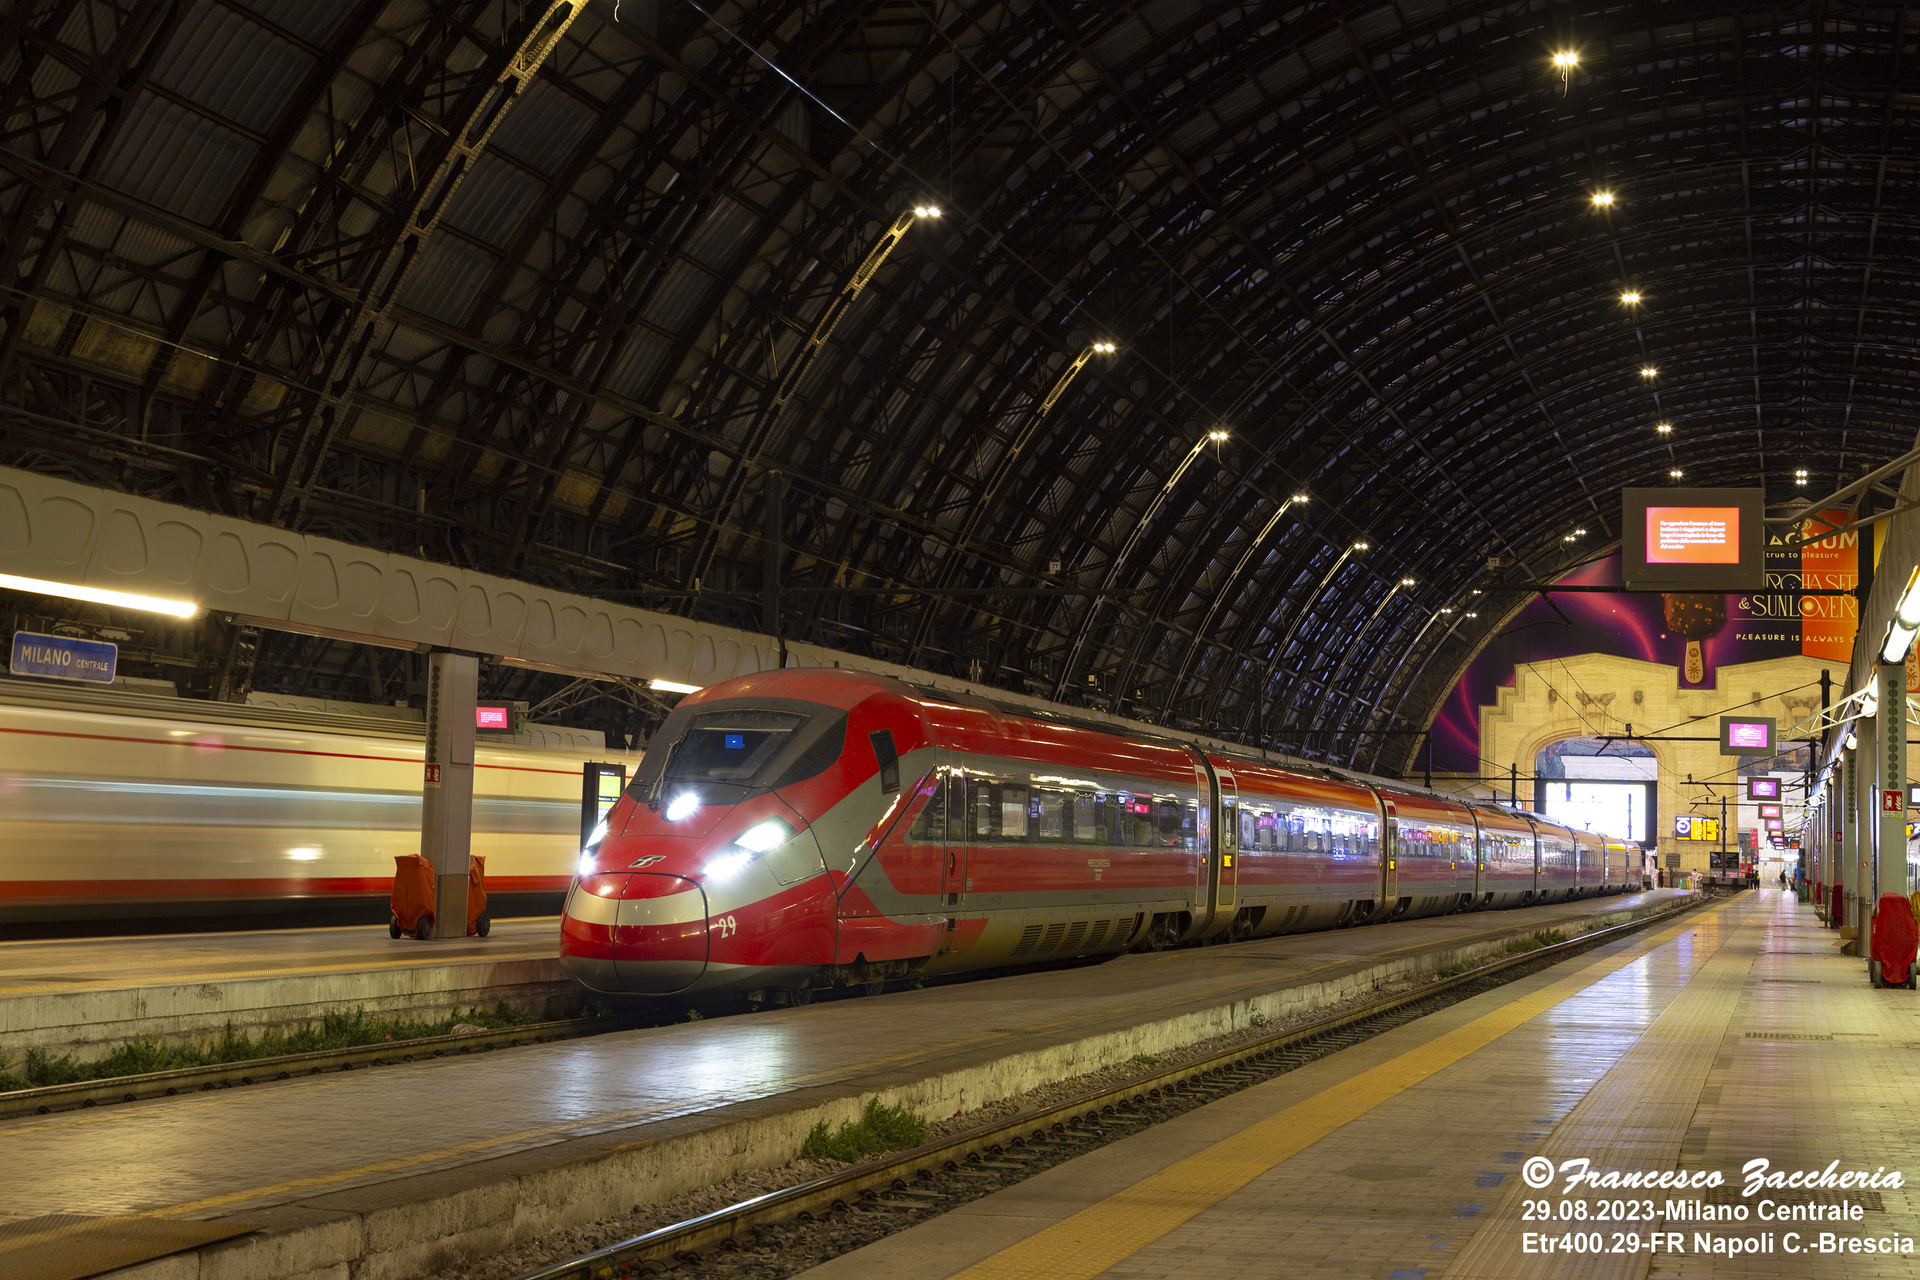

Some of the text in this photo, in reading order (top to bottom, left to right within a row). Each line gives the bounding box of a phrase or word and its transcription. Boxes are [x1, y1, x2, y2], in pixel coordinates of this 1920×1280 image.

[1766, 550, 1840, 560] true to pleasure
[1738, 597, 1752, 610] &
[1735, 633, 1786, 641] PLEASURE
[1791, 634, 1800, 642] IS
[1805, 635, 1844, 643] ALWAYS
[20, 645, 109, 671] MILANO CENTRALE
[719, 914, 737, 939] 29
